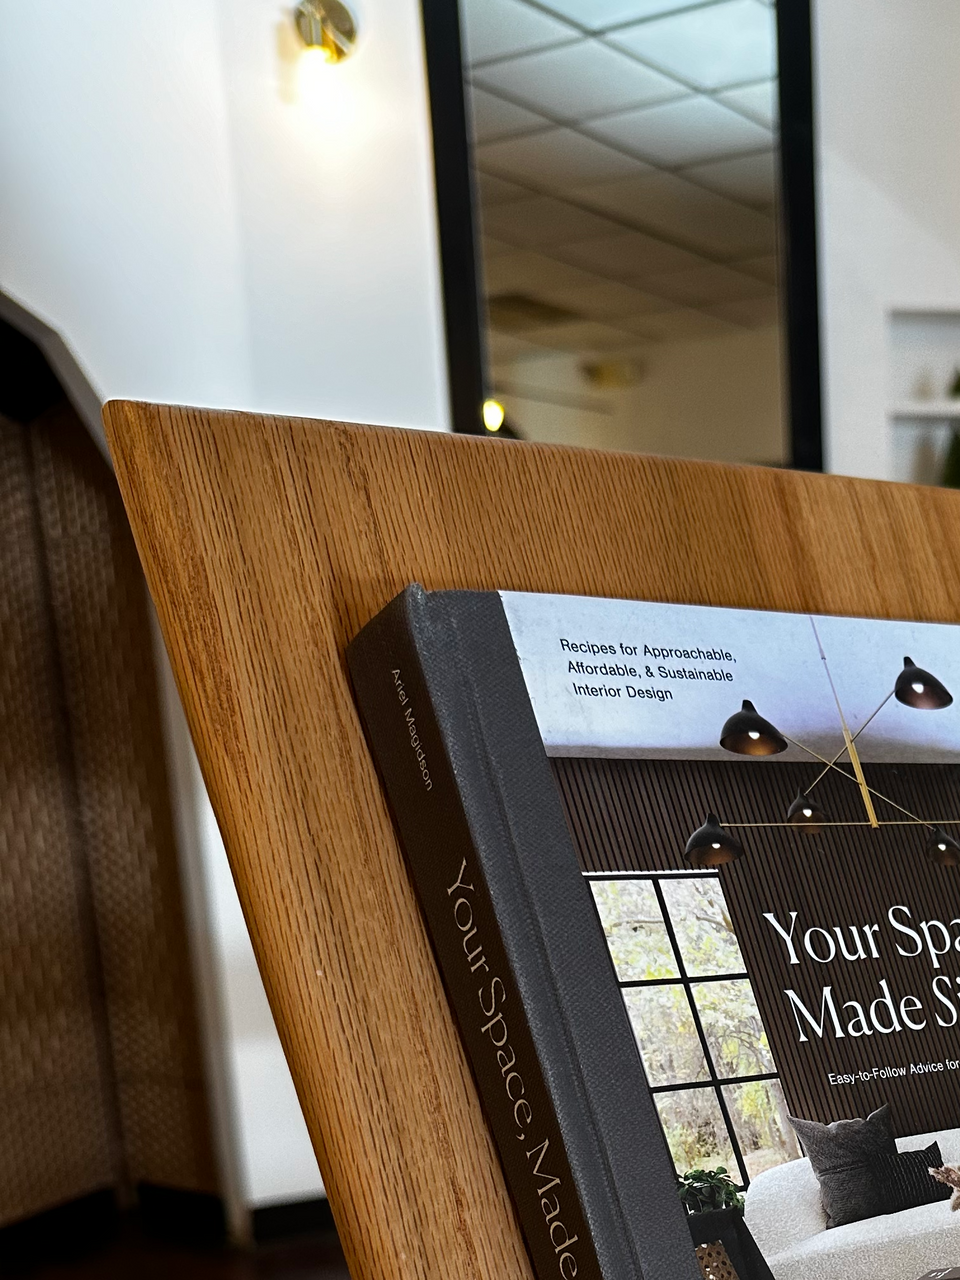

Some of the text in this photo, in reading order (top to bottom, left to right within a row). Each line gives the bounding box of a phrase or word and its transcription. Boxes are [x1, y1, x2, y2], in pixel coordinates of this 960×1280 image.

[560, 638, 738, 663] Recipes for Approachable,
[568, 660, 734, 682] Affordable, & Sustainable
[572, 682, 674, 702] Interior Design
[391, 669, 433, 791] Ariel Magidson
[762, 911, 880, 965] Your
[784, 979, 927, 1042] Made
[446, 857, 490, 973] Your
[478, 977, 533, 1141] Space,
[526, 1138, 579, 1280] Made
[828, 1067, 907, 1085] Easy-to-Follow
[910, 1061, 944, 1075] Advice
[945, 1057, 960, 1071] for
